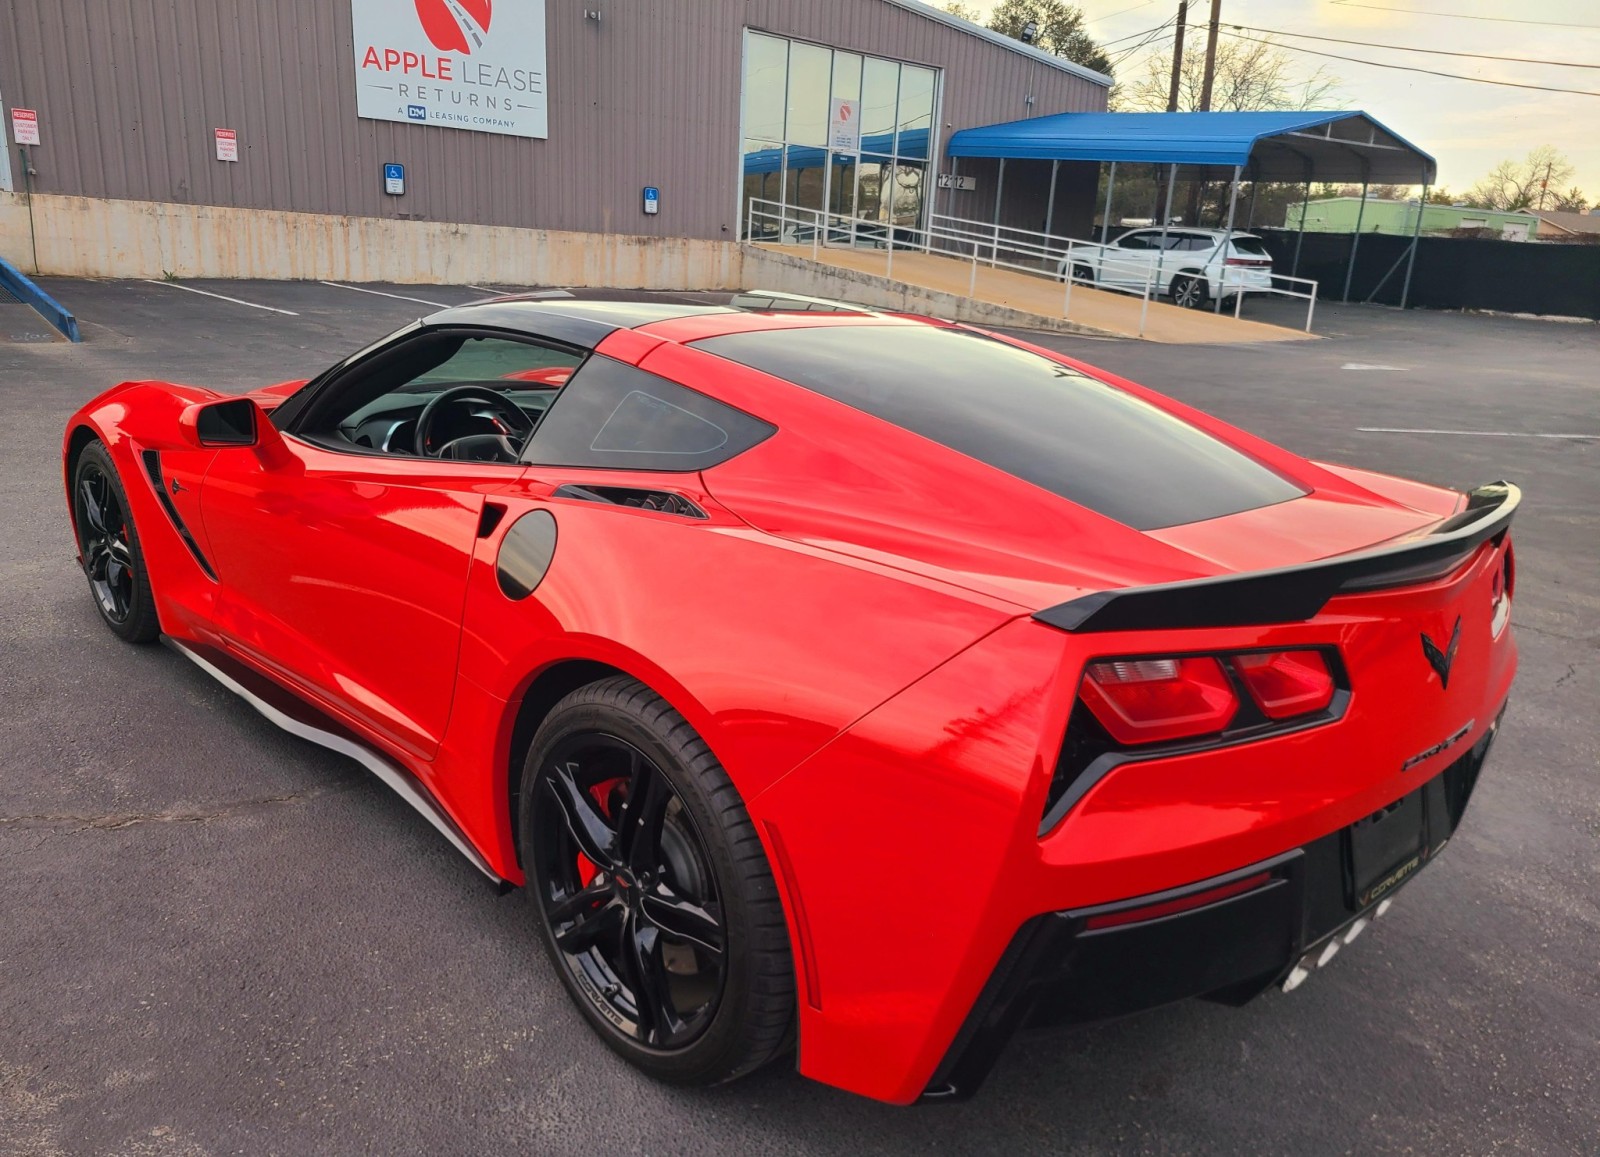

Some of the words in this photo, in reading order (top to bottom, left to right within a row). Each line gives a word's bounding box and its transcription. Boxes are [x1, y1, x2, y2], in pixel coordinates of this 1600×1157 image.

[362, 46, 453, 81] APPLE
[462, 61, 543, 94] LEASE
[398, 83, 513, 111] RETURNS
[397, 107, 404, 115] A
[430, 111, 469, 123] LEASING
[473, 116, 516, 128] COMPANY
[938, 174, 965, 189] 1212
[1370, 856, 1419, 900] CORVETTE
[578, 973, 624, 1026] CORVETTE
